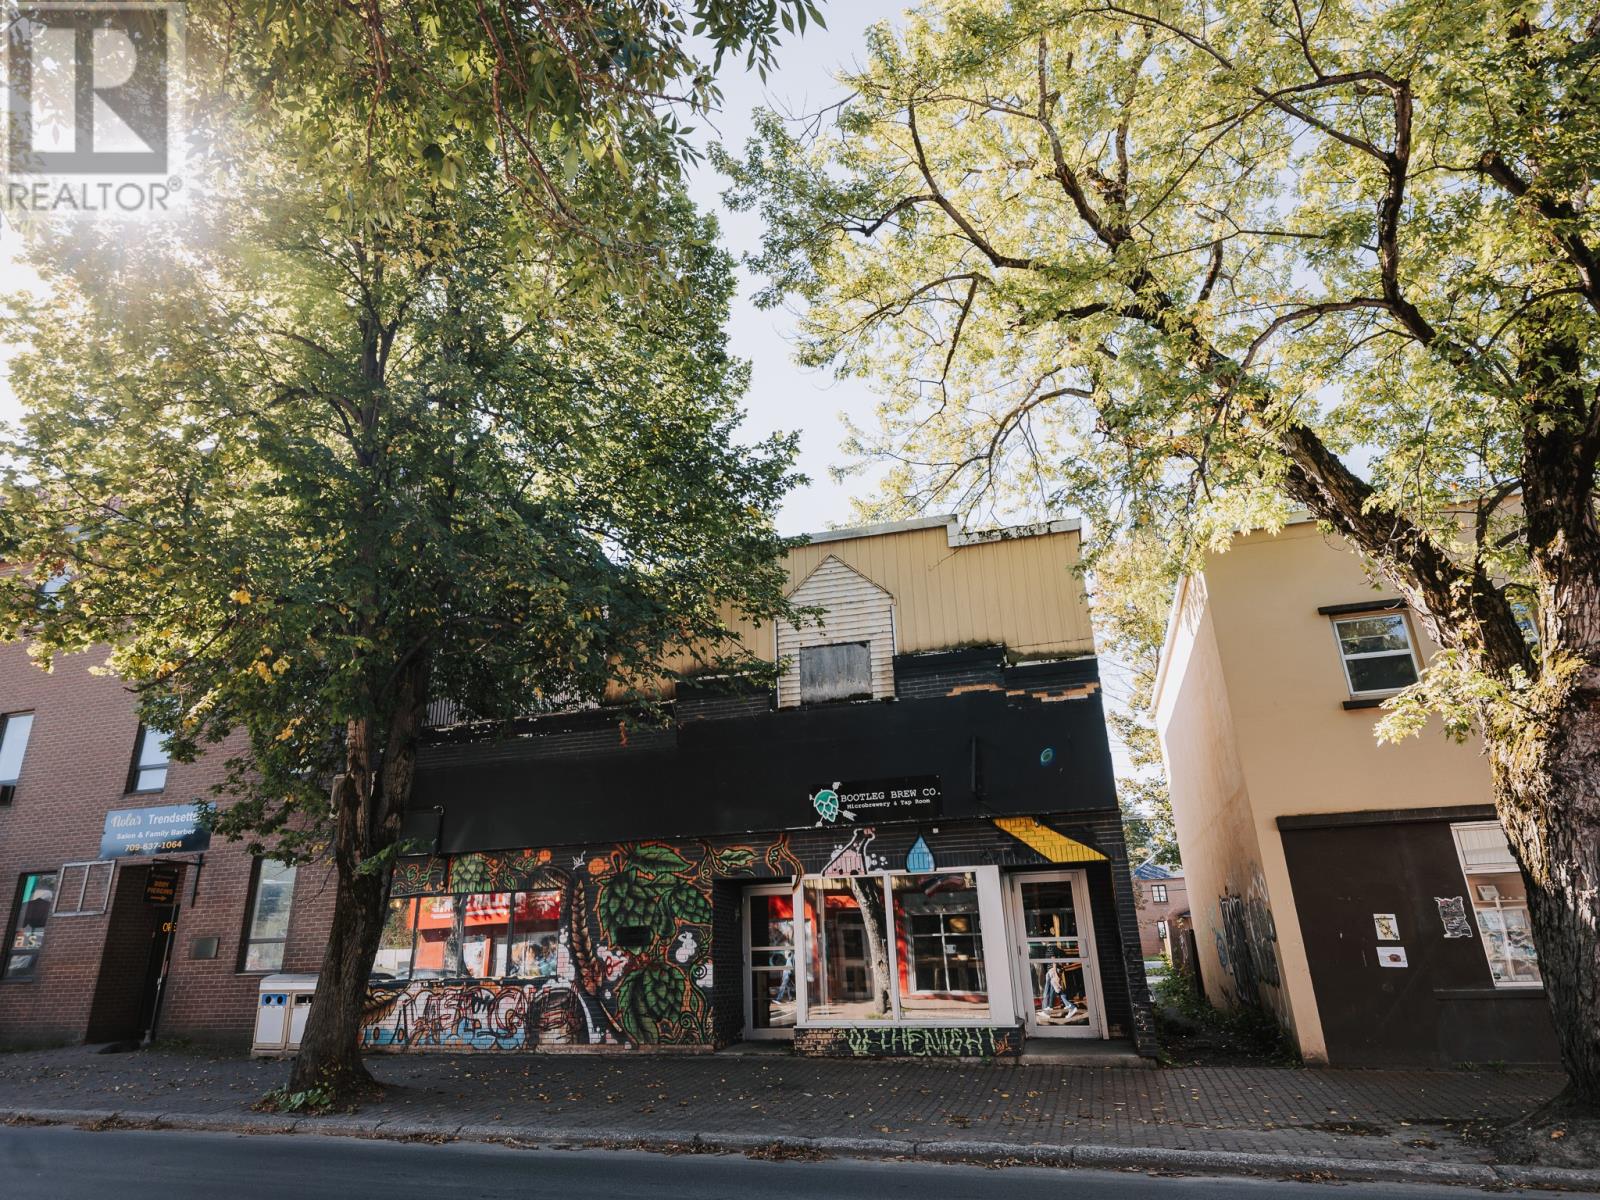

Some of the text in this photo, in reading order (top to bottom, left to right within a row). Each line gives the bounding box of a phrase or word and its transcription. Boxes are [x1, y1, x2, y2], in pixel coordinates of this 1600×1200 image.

[840, 787, 941, 803] BOOTLEG BREW CO.
[846, 801, 890, 810] Microbrewery
[116, 832, 136, 840] Salon
[145, 830, 169, 838] Family
[170, 828, 195, 836] Barber
